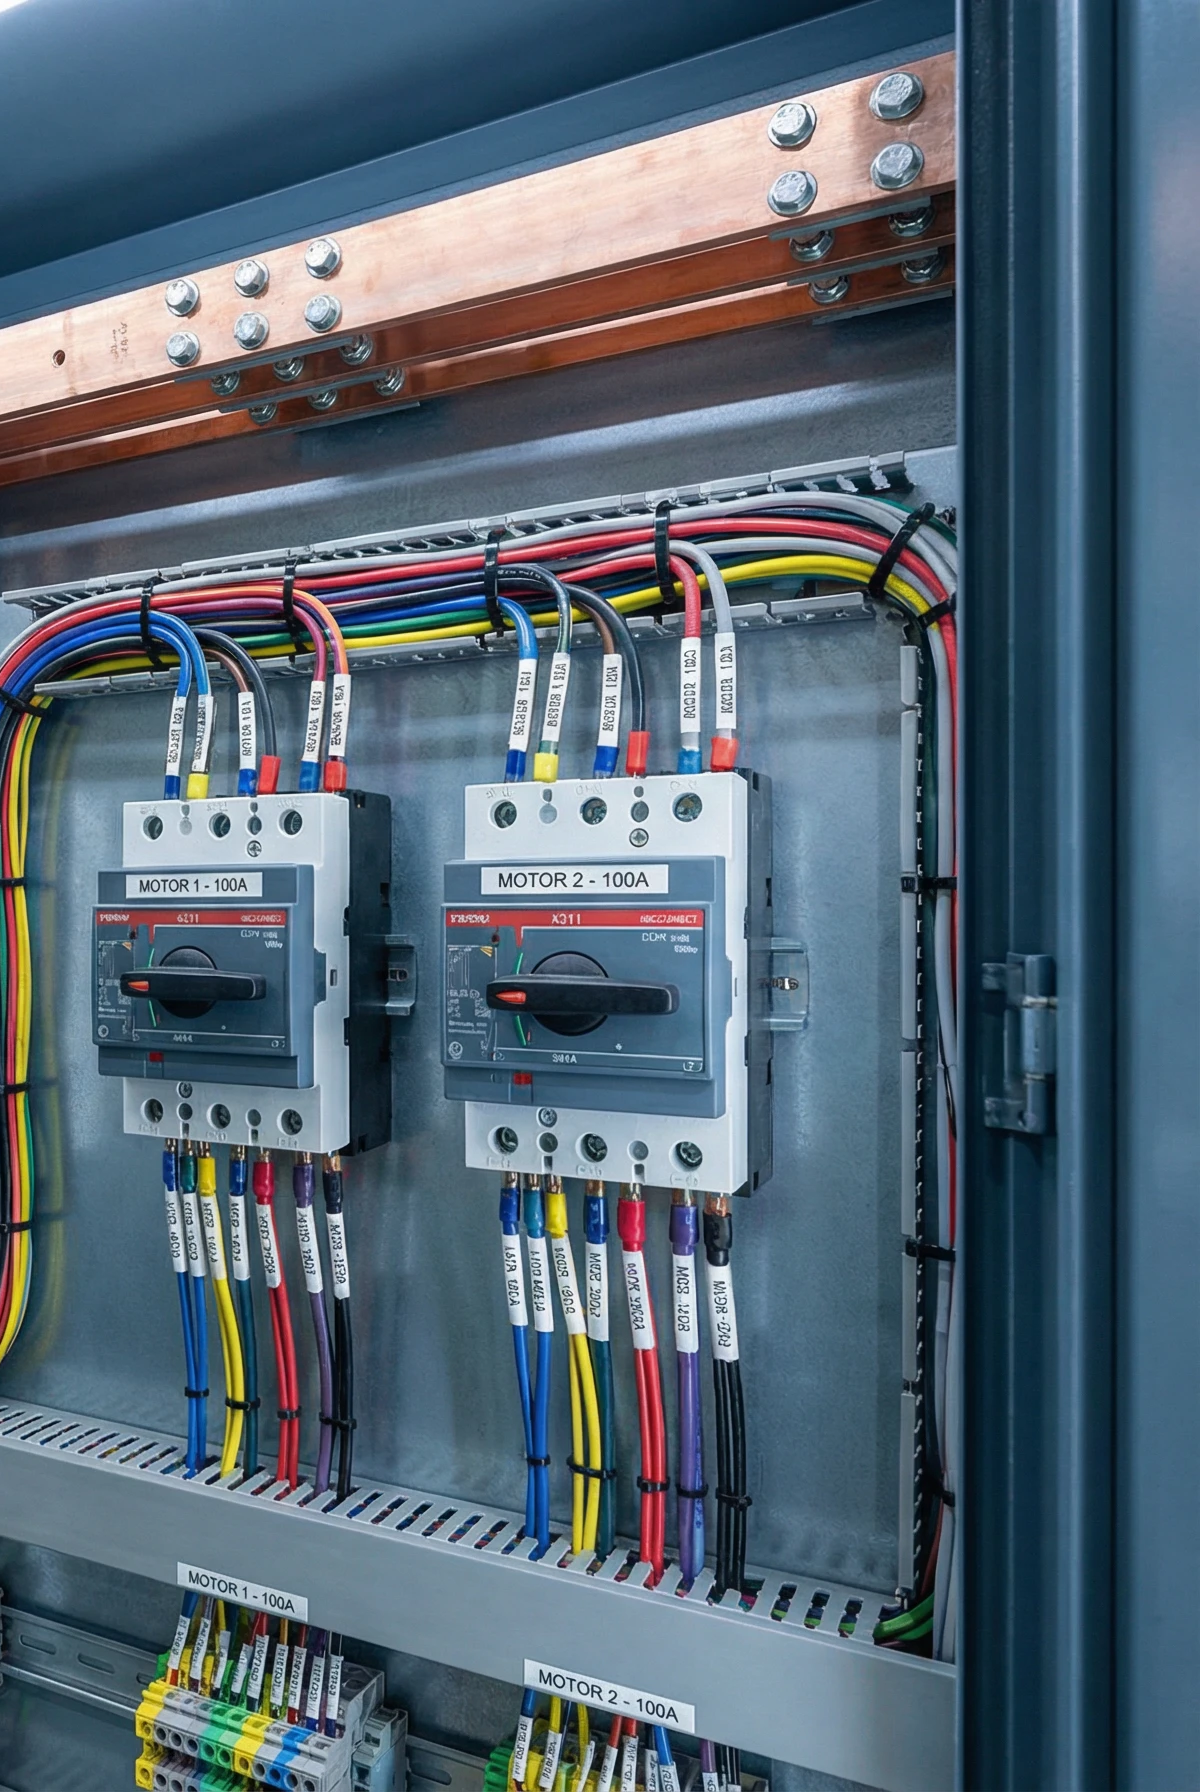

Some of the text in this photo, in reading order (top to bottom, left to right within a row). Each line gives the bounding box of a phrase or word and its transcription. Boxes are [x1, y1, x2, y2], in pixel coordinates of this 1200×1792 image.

[138, 879, 189, 892] MOTOR
[193, 879, 199, 892] 1
[215, 878, 248, 892] 100A
[498, 872, 568, 888] MOTOR
[572, 872, 584, 888] 2
[602, 871, 650, 888] 100A
[188, 1570, 238, 1597] MOTOR
[242, 1586, 248, 1599] 1
[262, 1592, 295, 1613] 100A
[539, 1669, 603, 1702] MOTOR
[608, 1690, 618, 1705] 2
[636, 1698, 679, 1723] 100A
